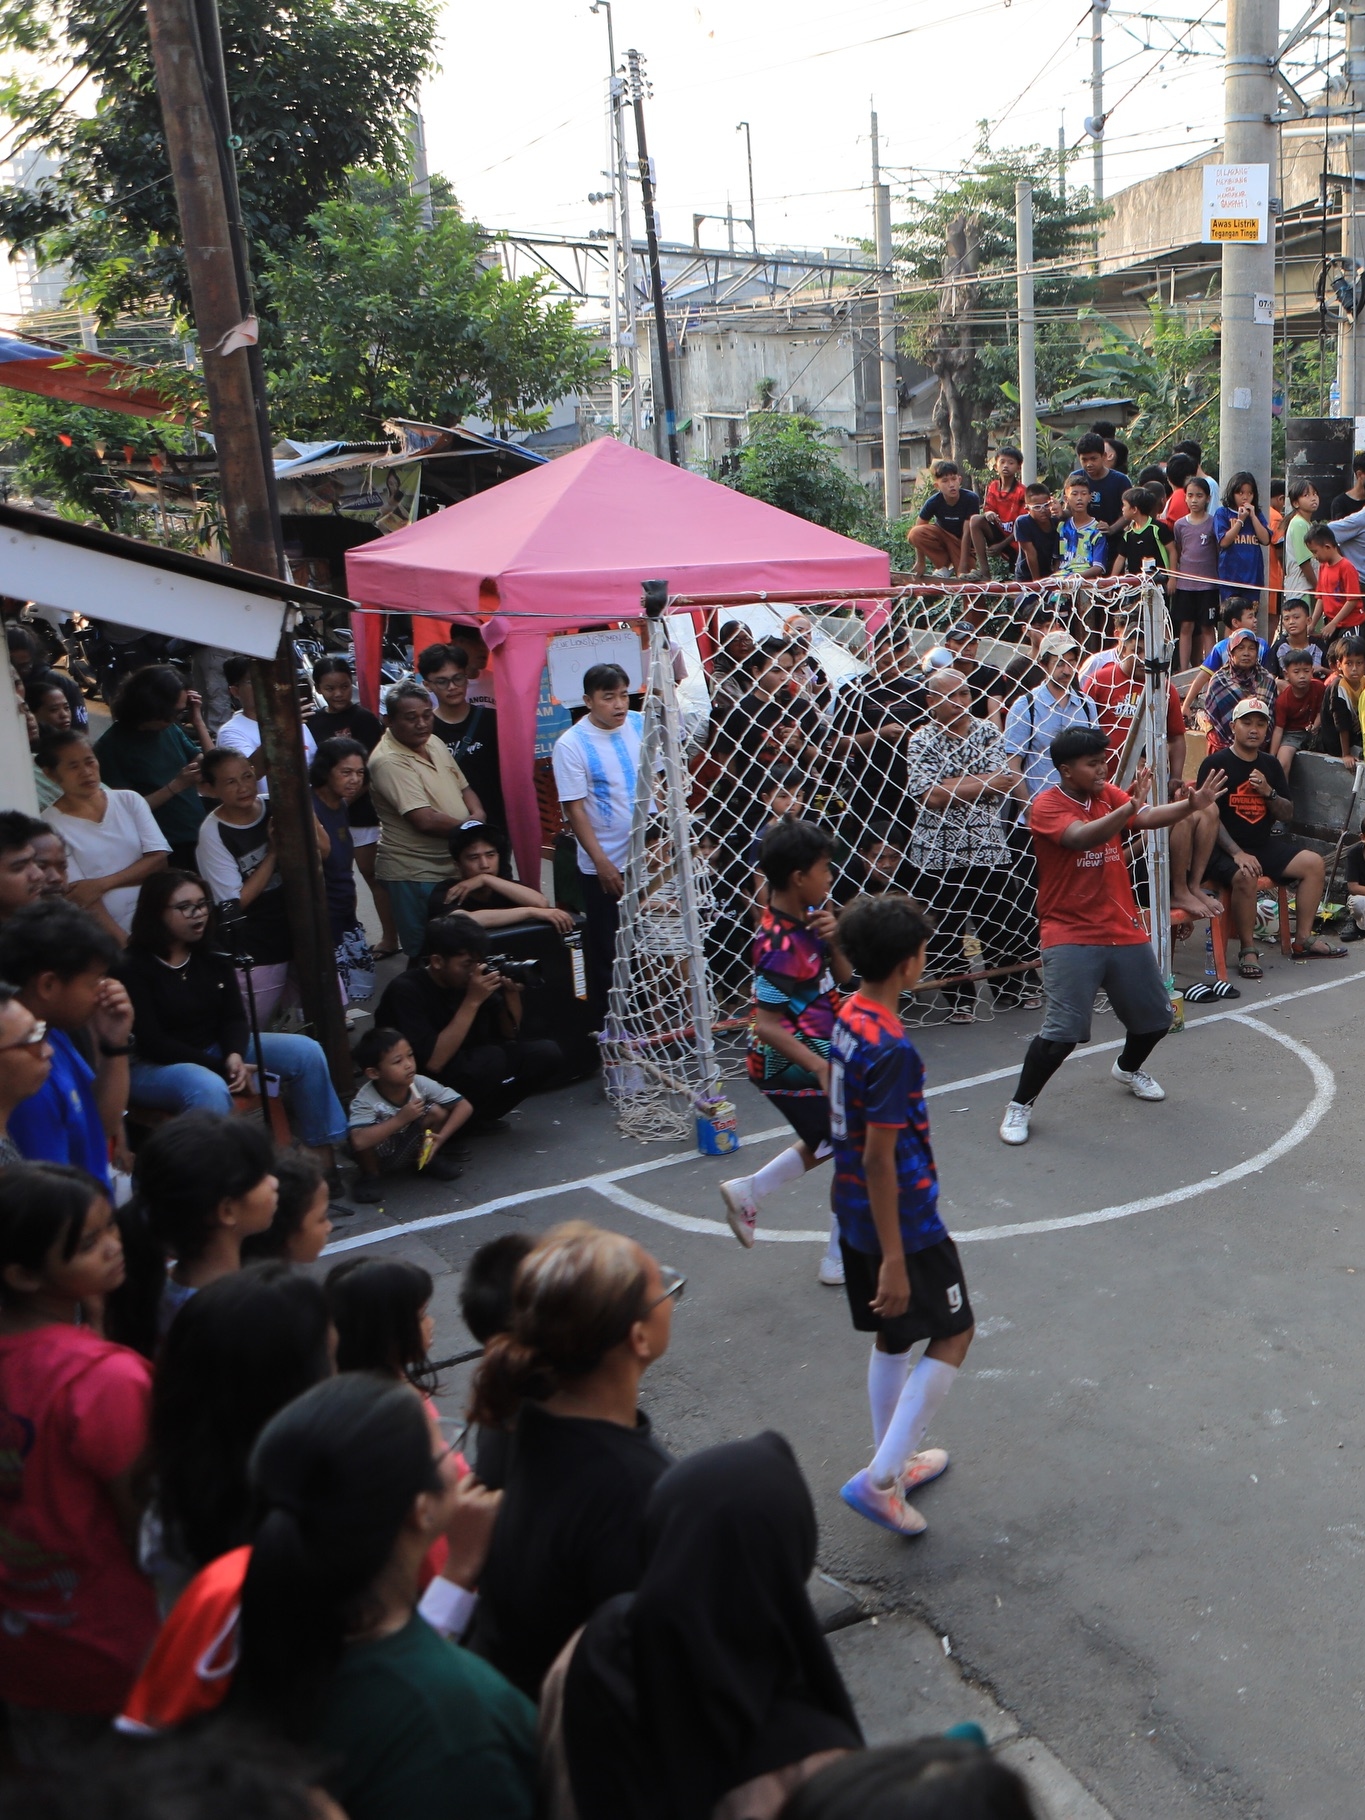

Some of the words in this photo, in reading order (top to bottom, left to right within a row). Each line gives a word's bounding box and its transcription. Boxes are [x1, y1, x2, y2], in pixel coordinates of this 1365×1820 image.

[1212, 219, 1232, 228] Awas
[1233, 219, 1256, 228] Listrik
[1211, 229, 1239, 239] Tegangan
[1240, 229, 1259, 239] Tinggi
[946, 1282, 963, 1314] 9
